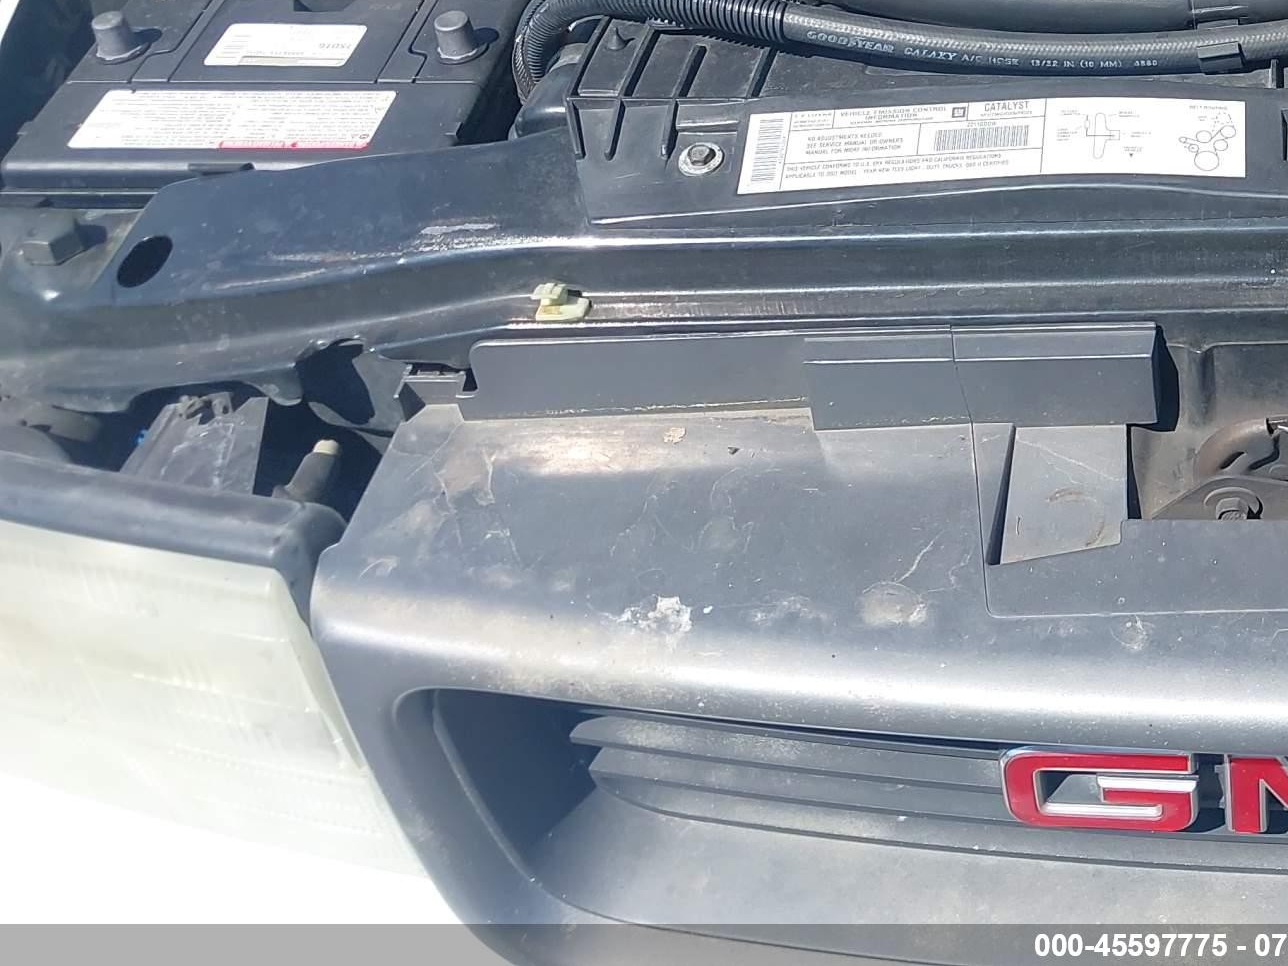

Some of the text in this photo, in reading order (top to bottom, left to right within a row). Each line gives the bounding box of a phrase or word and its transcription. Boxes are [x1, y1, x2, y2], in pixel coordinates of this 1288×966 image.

[806, 30, 896, 53] GOODYEAR
[904, 46, 958, 61] GALAXY
[1063, 59, 1075, 68] IN
[984, 100, 1031, 112] CATALYST
